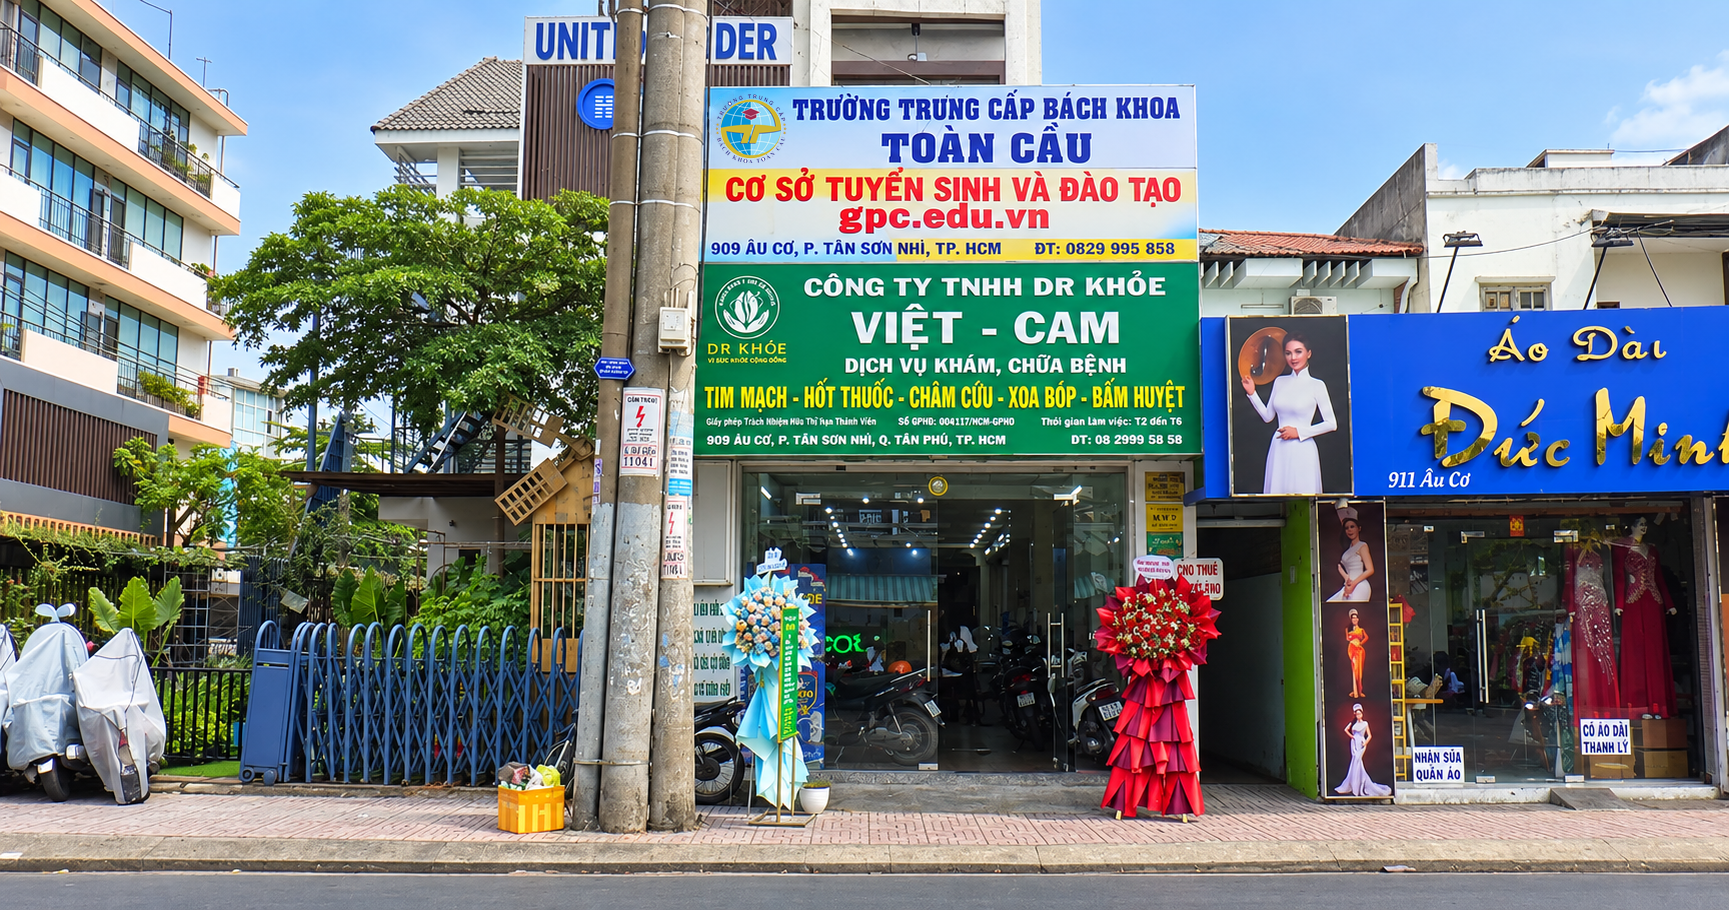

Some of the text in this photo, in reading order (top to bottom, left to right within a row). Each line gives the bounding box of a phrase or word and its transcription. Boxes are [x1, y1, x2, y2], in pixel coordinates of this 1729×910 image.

[793, 93, 890, 121] TRƯỜNG
[988, 89, 1035, 120] CẤP
[1043, 92, 1107, 120] BÁCH
[1116, 97, 1180, 119] KHOA
[881, 122, 1092, 163] TOÀN CẦU
[726, 167, 1181, 207] CƠ SỞ TUYỂN SINH VÀ ĐÀO TẠO
[839, 202, 1049, 234] gpc.edu.vn
[711, 242, 740, 255] 909
[745, 239, 767, 255] ÂU
[772, 240, 799, 257] CƠ,
[804, 242, 818, 255] P.
[823, 240, 857, 255] TÂN
[861, 240, 892, 255] SƠN
[935, 242, 960, 255] TP.
[966, 242, 1001, 255] HCM
[1035, 242, 1175, 255] ĐT: 0829 995 858
[804, 270, 1166, 296] CÔNG TY TNHH DR KHỎE
[851, 303, 963, 351] VIỆT
[1014, 311, 1120, 344] CAM
[707, 343, 731, 355] DR
[1488, 315, 1667, 362] Áo Dài
[845, 354, 1126, 377] DỊCH VỤ KHÁM, CHỮA BỆNH
[704, 386, 734, 408] TIM
[741, 386, 787, 412] MẠCH
[804, 378, 836, 408] HỐT
[840, 378, 894, 408] THUỐC
[910, 381, 955, 408] CHÂM
[961, 380, 993, 408] CỨU
[1008, 386, 1040, 408] XOA
[1045, 381, 1077, 408] BÓP
[1092, 378, 1128, 408] BẤM
[1134, 380, 1185, 412] HUYỆT
[1064, 417, 1085, 428] gian
[1134, 417, 1147, 426] T2
[1169, 417, 1183, 426] T6
[1421, 386, 1729, 468] Đức Min
[706, 435, 730, 445] 909
[778, 435, 790, 445] P.
[821, 433, 847, 445] SƠN
[879, 435, 891, 446] Q.
[894, 433, 919, 445] TÂN
[923, 432, 953, 447] PHÚ,
[955, 435, 975, 445] TP.
[978, 435, 1006, 445] HCM
[1095, 435, 1110, 445] 08
[1114, 435, 1144, 445] 2999
[1148, 435, 1163, 445] 58
[1167, 435, 1183, 445] 58
[1388, 468, 1471, 488] 911 Âu Cơ
[1583, 721, 1595, 737] CÓ
[1613, 721, 1628, 737] DÀI
[1583, 739, 1628, 753] THANH LÝ
[1447, 766, 1461, 780] ÁO
